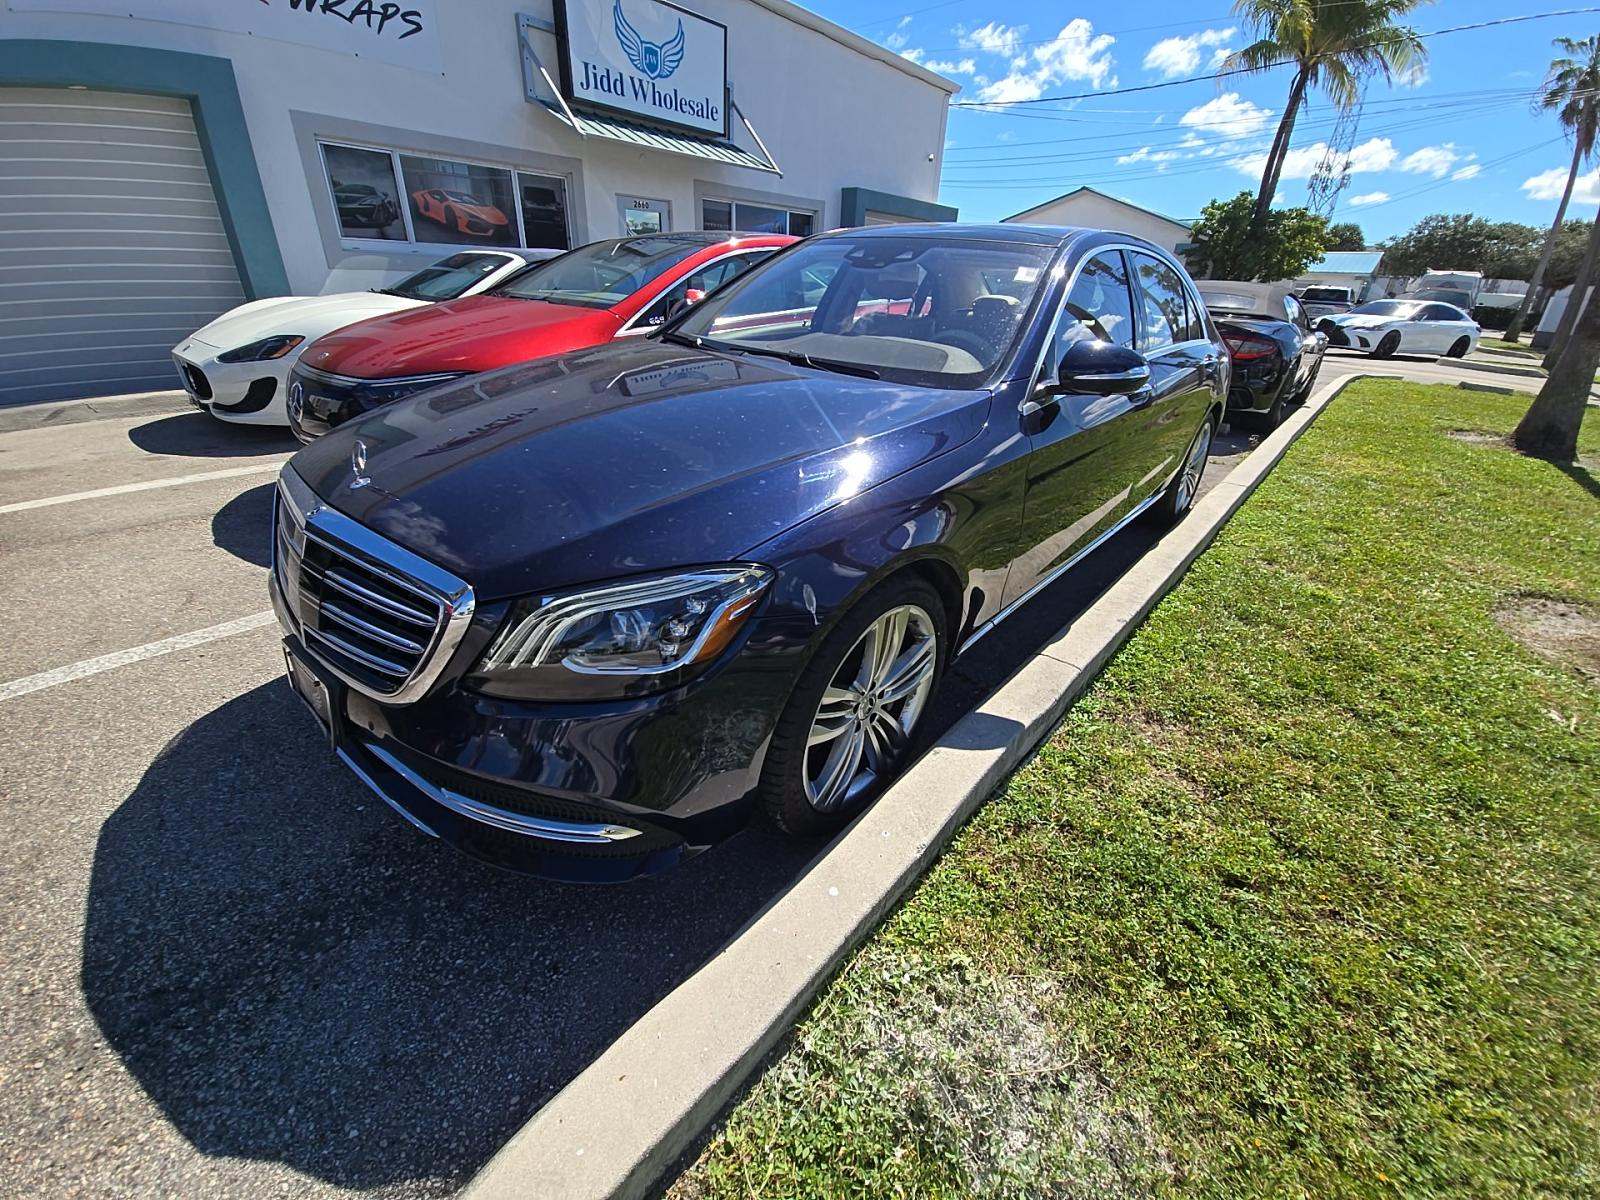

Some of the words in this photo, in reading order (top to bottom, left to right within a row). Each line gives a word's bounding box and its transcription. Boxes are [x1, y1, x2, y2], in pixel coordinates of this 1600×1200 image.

[580, 61, 626, 97] Jidd
[629, 75, 719, 122] Wholesale
[633, 200, 650, 209] 2660
